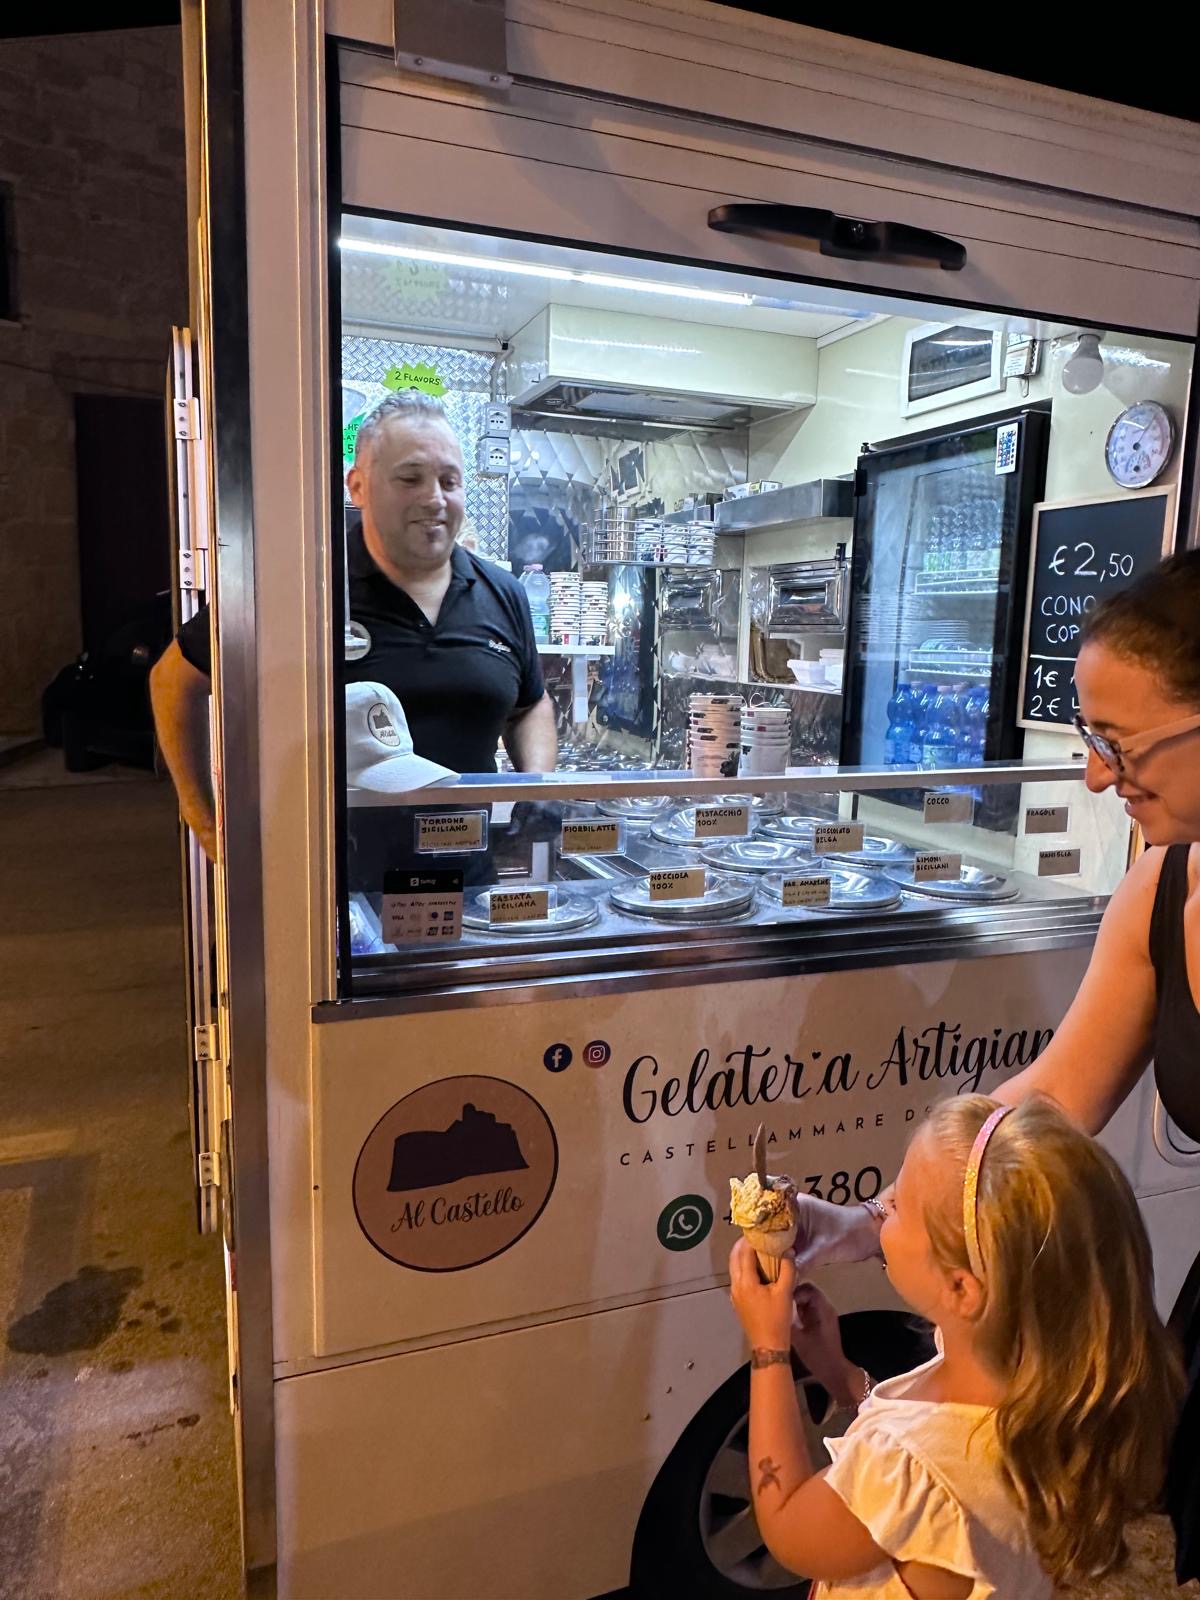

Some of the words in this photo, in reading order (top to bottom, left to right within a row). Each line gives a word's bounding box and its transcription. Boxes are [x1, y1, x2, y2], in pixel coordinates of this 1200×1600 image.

[394, 370, 402, 381] 2
[403, 373, 441, 386] FLAVORS
[1048, 542, 1134, 583] €2,50
[1041, 595, 1097, 616] CONO
[1045, 623, 1080, 643] COP
[926, 797, 950, 805] COCCO
[696, 809, 742, 818] PISTACCHIO
[421, 817, 464, 825] TORRONE
[697, 818, 717, 827] 100%
[421, 824, 468, 833] SICILIANO
[916, 863, 949, 871] SICILIANI
[651, 872, 689, 881] NOCCIOLA
[652, 882, 674, 890] 100%
[491, 893, 532, 902] CASSATA
[491, 900, 537, 911] SICILIANA
[622, 1044, 860, 1124] Gelatera
[866, 1021, 1054, 1094] Artigian
[620, 1113, 885, 1166] CASTELLAMMARE
[391, 1200, 425, 1233] Al
[430, 1186, 524, 1226] Castello
